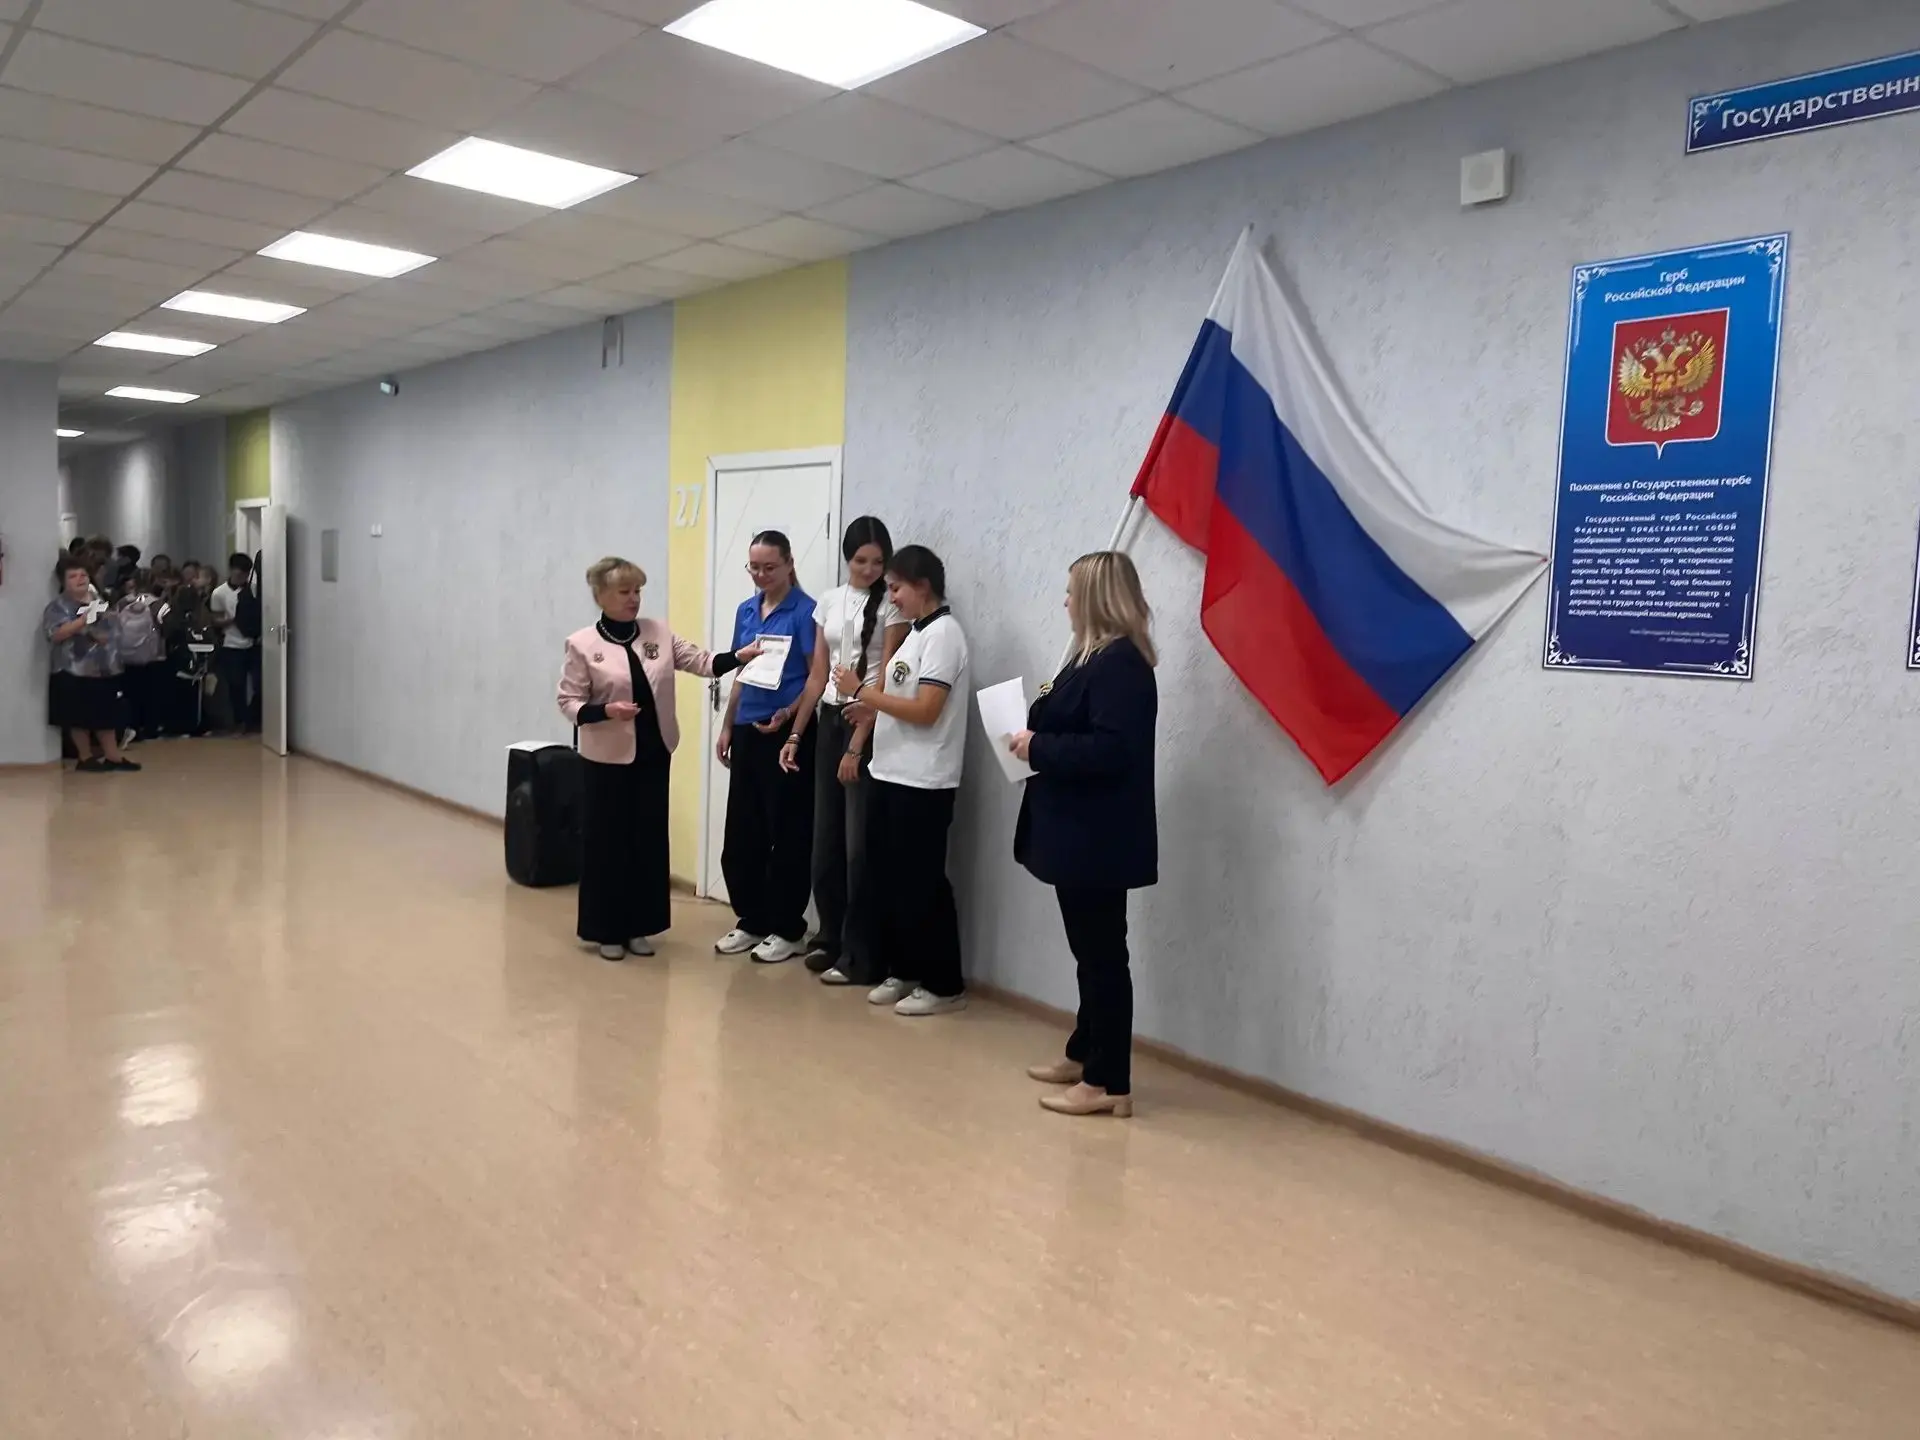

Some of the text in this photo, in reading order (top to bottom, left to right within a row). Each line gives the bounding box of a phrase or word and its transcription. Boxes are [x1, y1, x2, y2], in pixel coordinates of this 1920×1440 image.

[1660, 267, 1688, 285] Герб
[1604, 275, 1746, 303] Российской Федерации
[1569, 475, 1752, 492] Положение о Государственном гербе
[1600, 491, 1714, 503] Российской Федерации
[675, 484, 703, 528] 27
[1585, 511, 1738, 524] Государственный герб Российской
[1574, 526, 1626, 535] Федерации
[1705, 523, 1737, 532] собой
